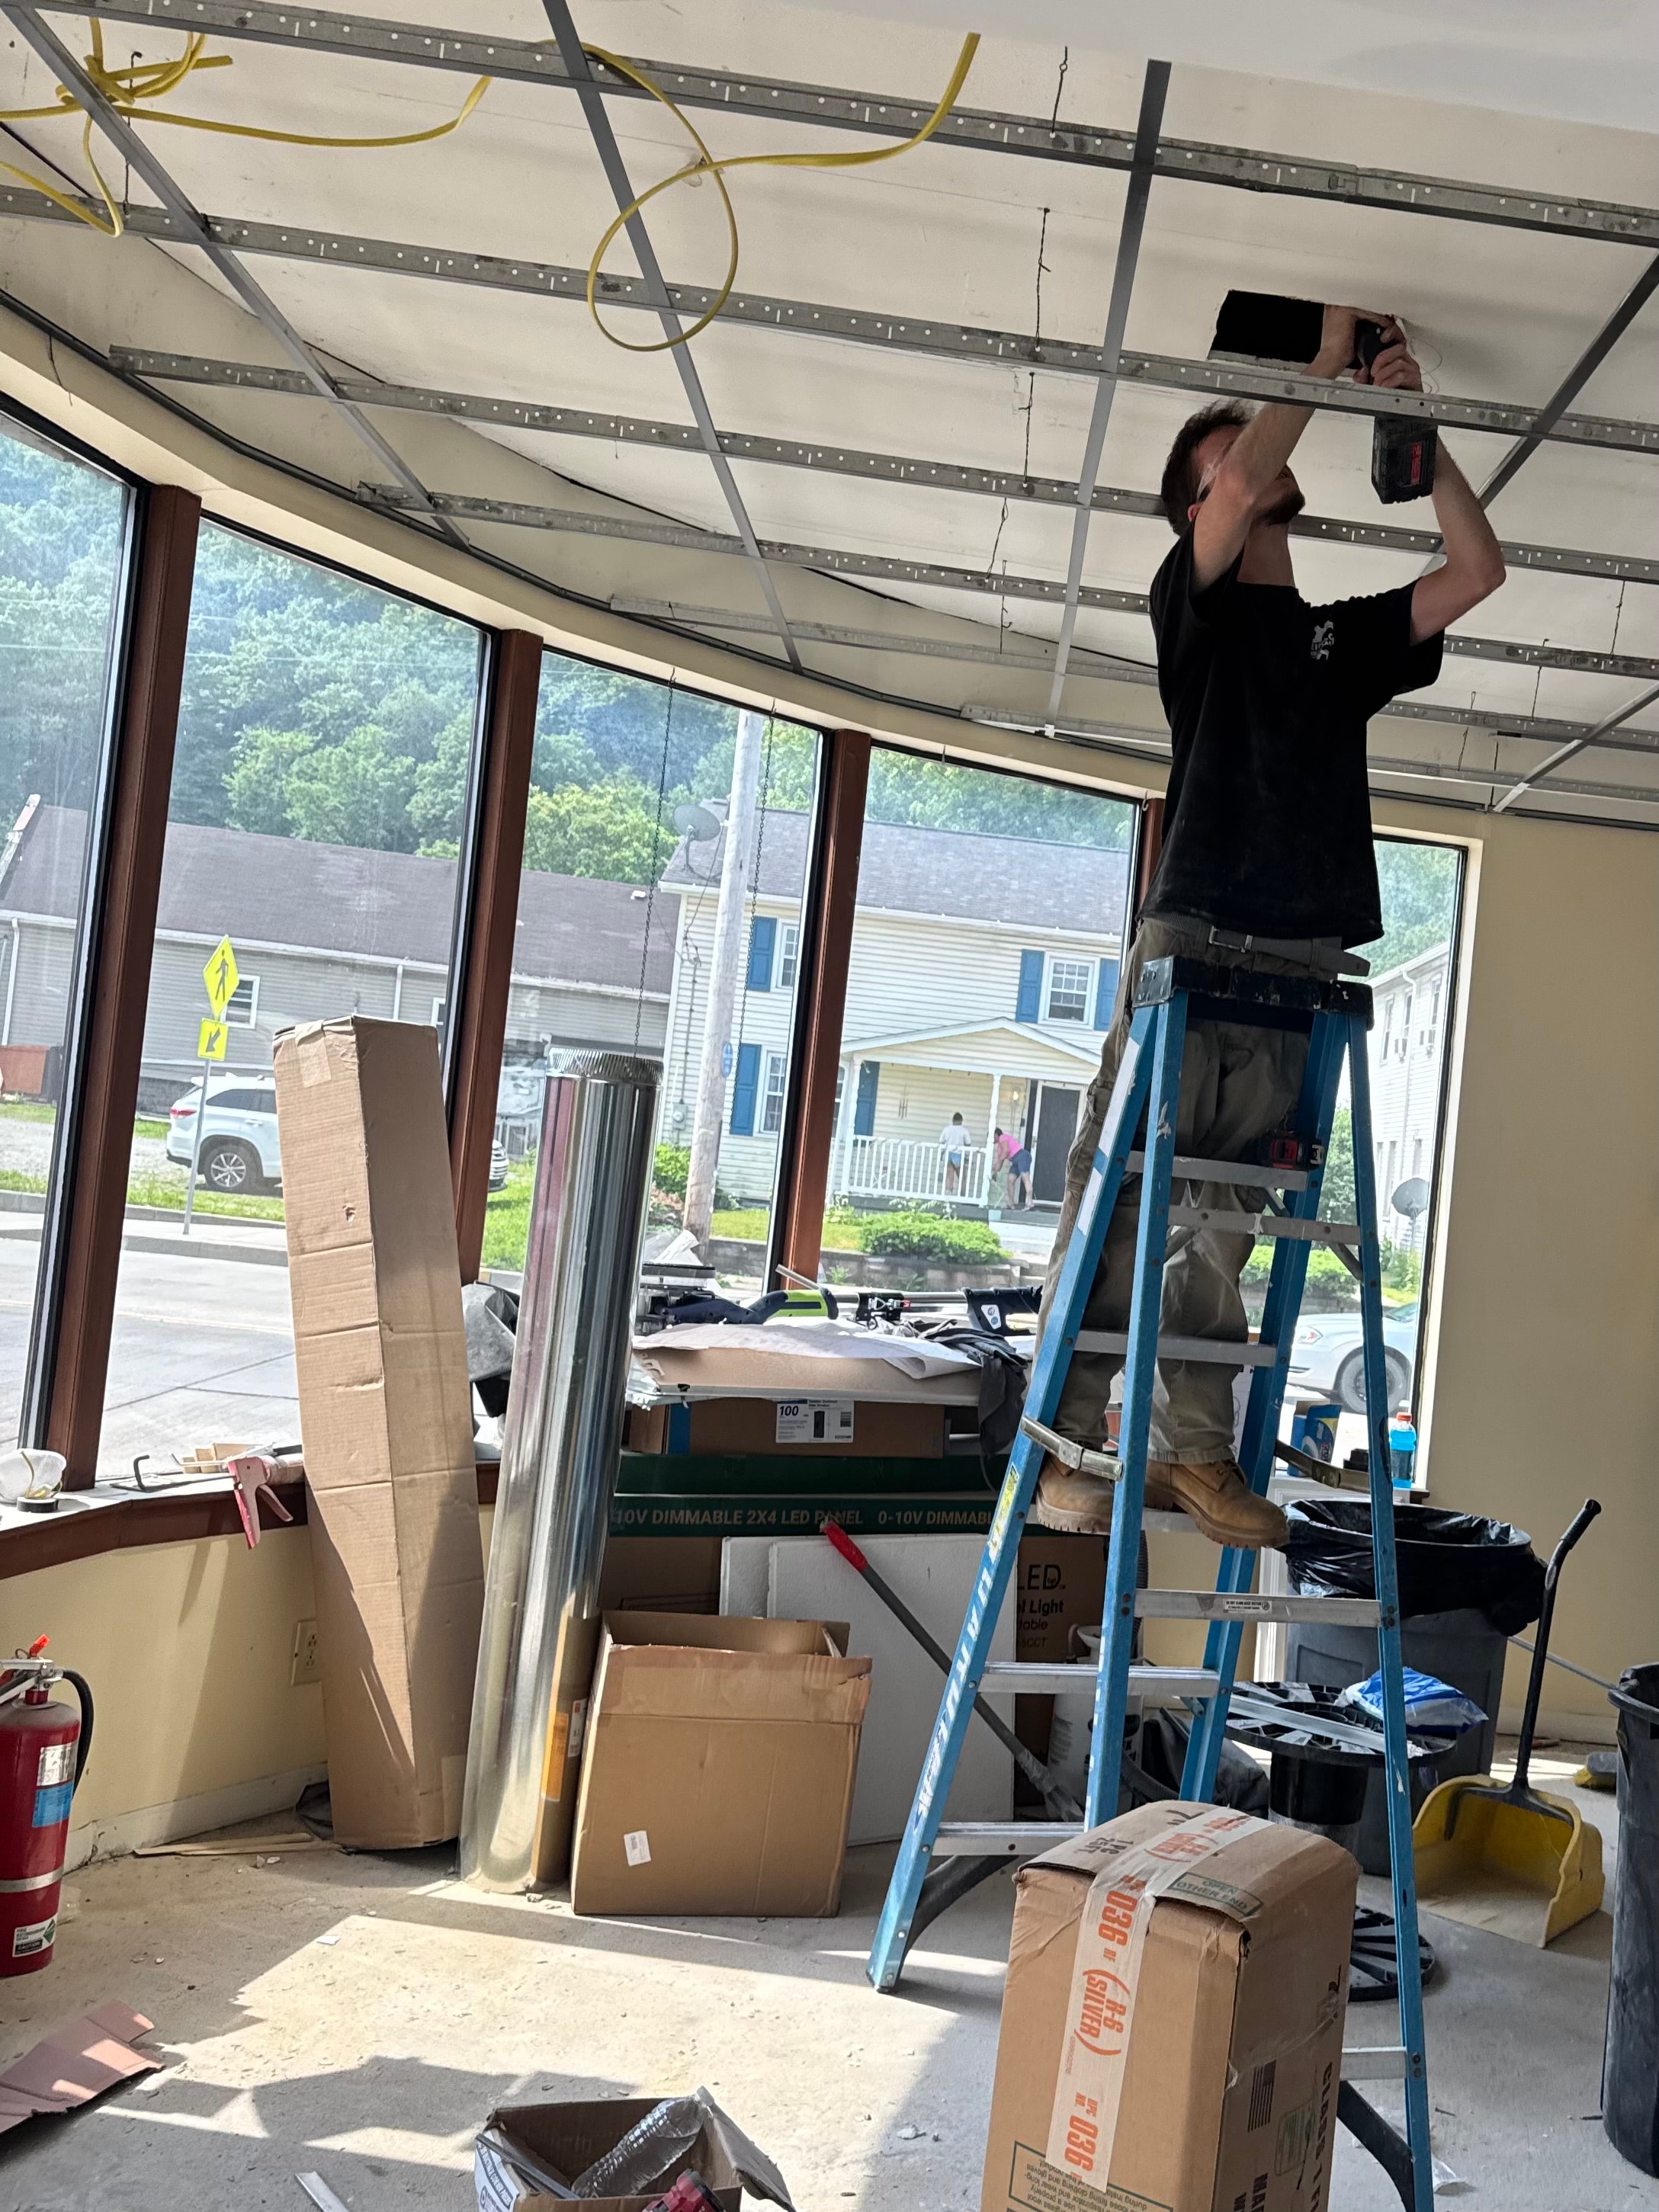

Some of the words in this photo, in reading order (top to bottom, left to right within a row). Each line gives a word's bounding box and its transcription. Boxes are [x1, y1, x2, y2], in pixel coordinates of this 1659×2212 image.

[779, 1406, 799, 1416] 100
[652, 1509, 743, 1525] DIMMABLE
[746, 1509, 777, 1525] 2X4
[781, 1510, 810, 1525] LED
[878, 1510, 923, 1525] 0-10V
[1017, 1563, 1062, 1590] ED
[1029, 1598, 1065, 1617] Light
[1098, 1890, 1138, 1947] 036
[1079, 1974, 1109, 2039] SILVER
[1102, 1998, 1128, 2034] R-6
[1064, 2114, 1099, 2172] 036
[1026, 2162, 1047, 2178] gloves
[1048, 2173, 1060, 2185] and
[1030, 2183, 1056, 2203] properly
[1057, 2188, 1070, 2199] and
[1061, 2178, 1088, 2197] clothing
[1124, 2194, 1147, 2212] during
